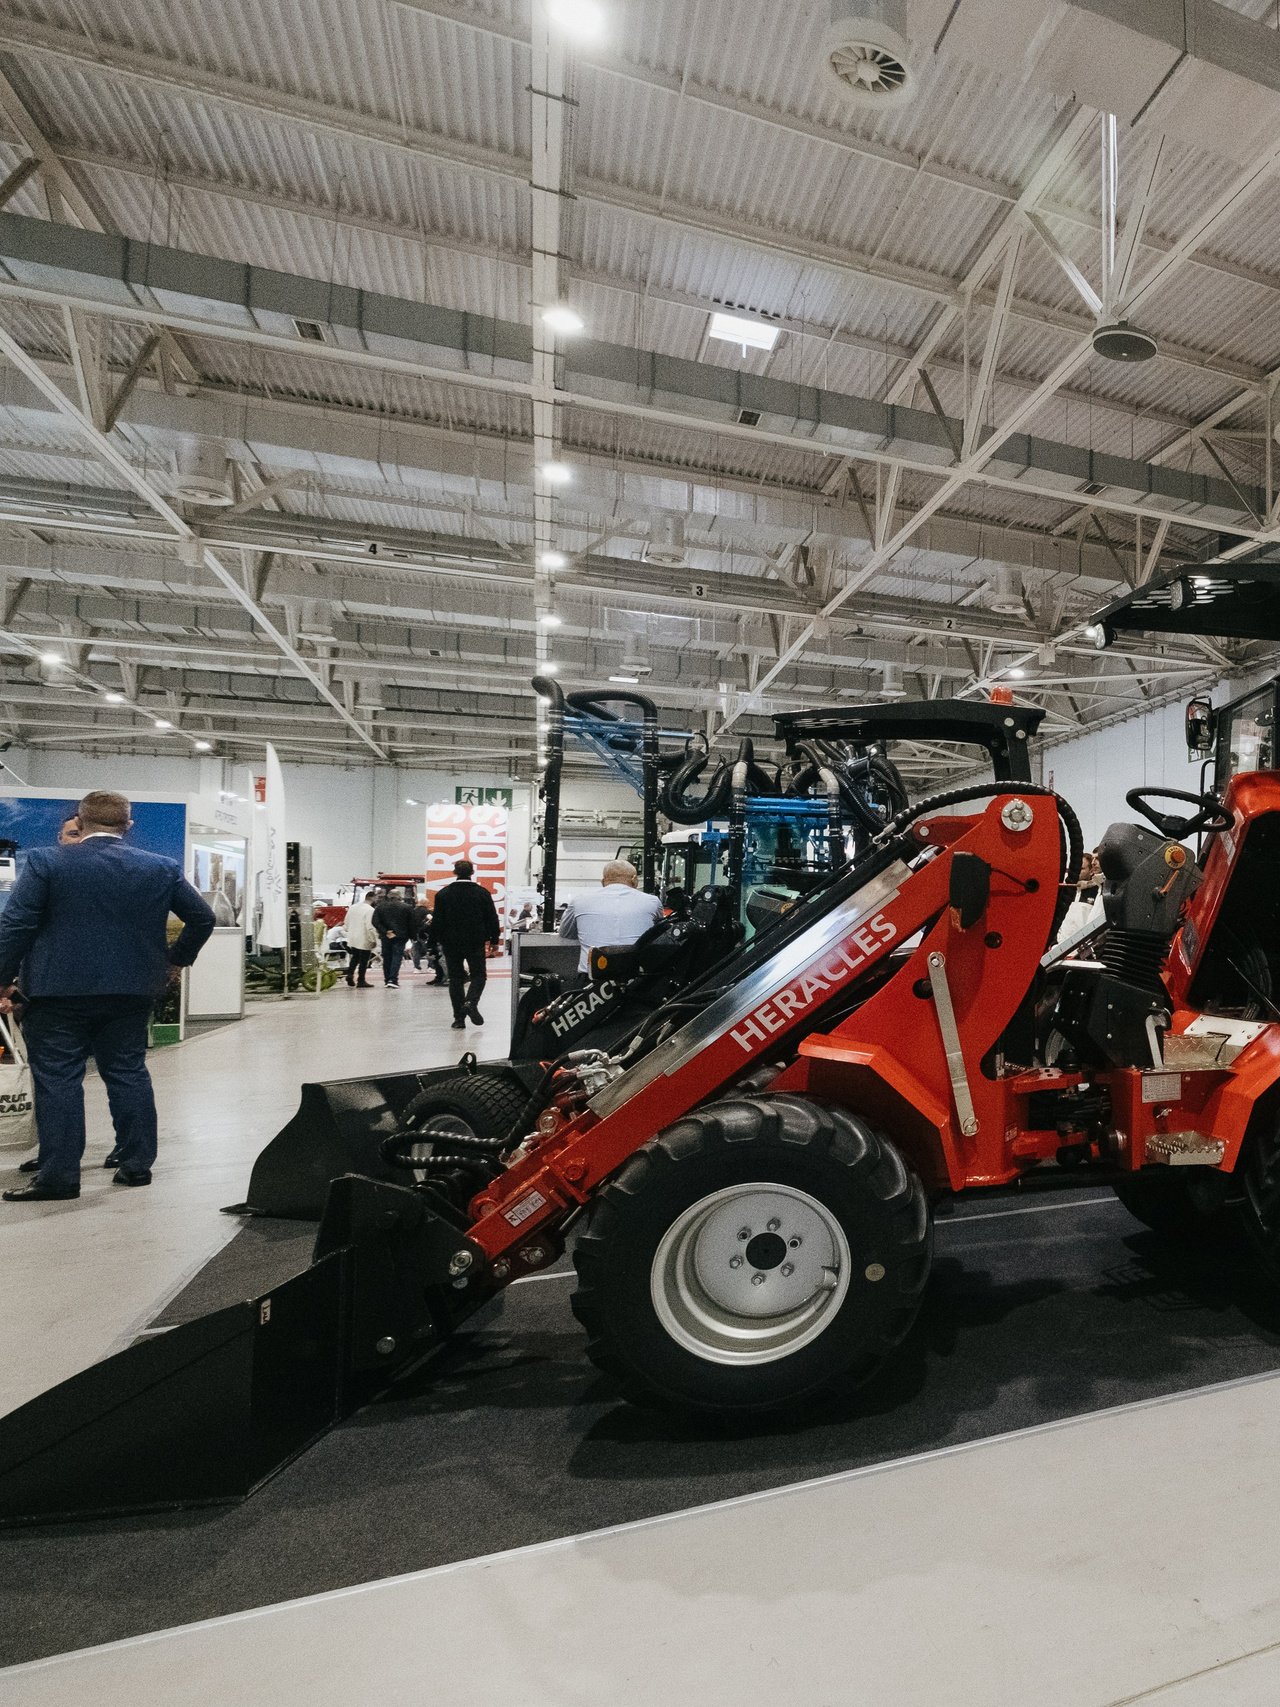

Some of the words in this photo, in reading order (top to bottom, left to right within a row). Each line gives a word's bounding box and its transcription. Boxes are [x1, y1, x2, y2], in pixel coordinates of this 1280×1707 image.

[369, 543, 377, 555] 4
[696, 585, 703, 596] 3
[947, 619, 953, 629] 2
[426, 803, 467, 893] ARUS
[729, 913, 898, 1053] HERACLES
[551, 980, 617, 1038] HERAC
[0, 1101, 32, 1113] RADE
